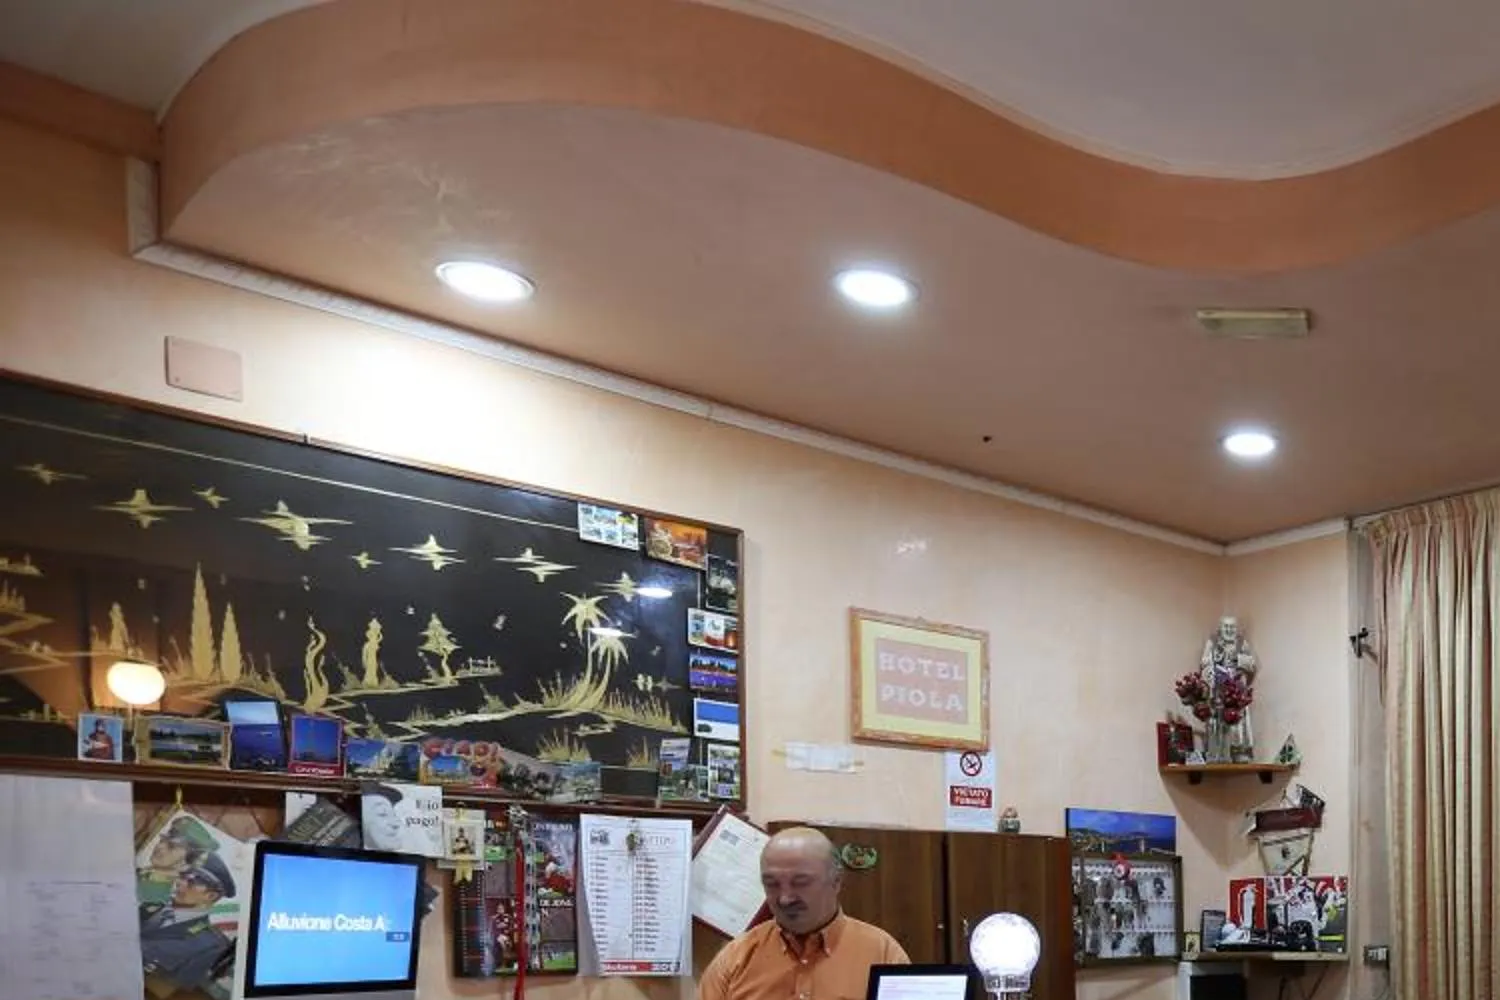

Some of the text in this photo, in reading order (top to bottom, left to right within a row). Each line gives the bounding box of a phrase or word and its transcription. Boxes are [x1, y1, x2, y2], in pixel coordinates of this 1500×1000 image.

[879, 651, 965, 680] HOTEL
[879, 684, 963, 711] PIOLA
[404, 814, 439, 828] pago!
[267, 911, 332, 931] Alluvione
[334, 913, 373, 931] Costa
